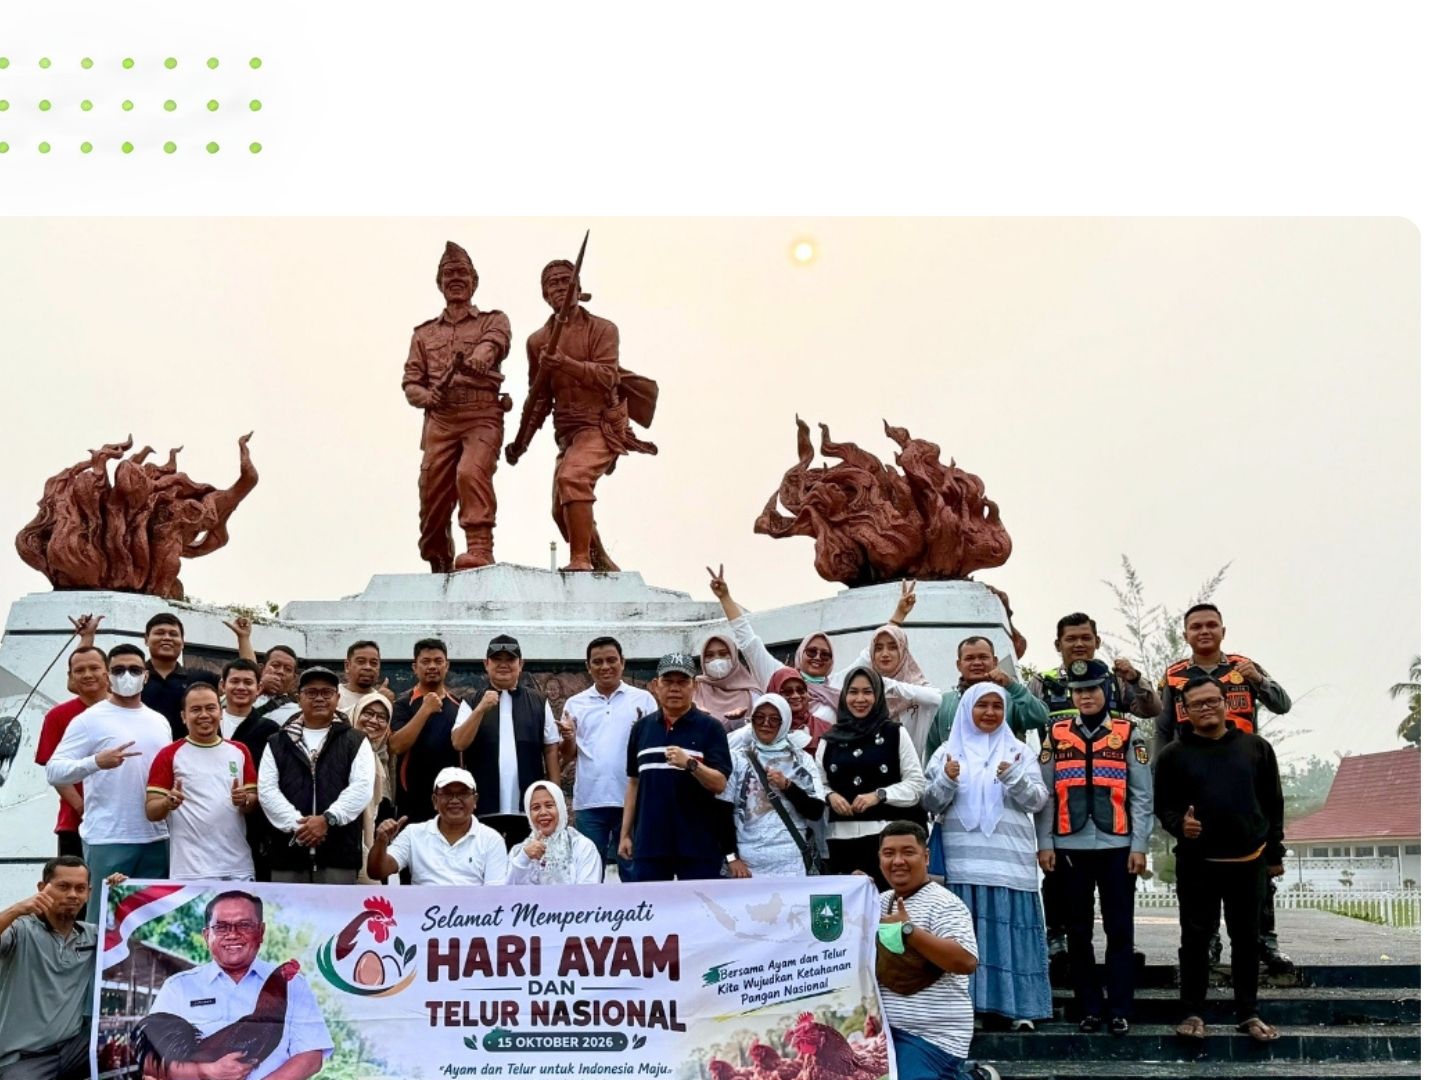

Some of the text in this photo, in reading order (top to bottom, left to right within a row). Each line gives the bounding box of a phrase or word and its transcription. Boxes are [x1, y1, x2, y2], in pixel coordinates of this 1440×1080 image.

[421, 901, 654, 931] Selamat Memperingati
[427, 934, 680, 982] HARI AYAM
[719, 948, 847, 981] Bersama Ayam dan Telur
[528, 980, 575, 995] DAN
[717, 962, 851, 996] Kita Wujudkan Ketahanan
[741, 978, 829, 1006] Pangan Nasional
[425, 1000, 687, 1032] TELUR NASIONAL
[497, 1037, 613, 1048] 15 OKTOBER 2026
[480, 1063, 503, 1075] dan
[507, 1063, 536, 1075] Telur
[539, 1063, 574, 1075] untuk
[579, 1062, 634, 1075] Indonesia
